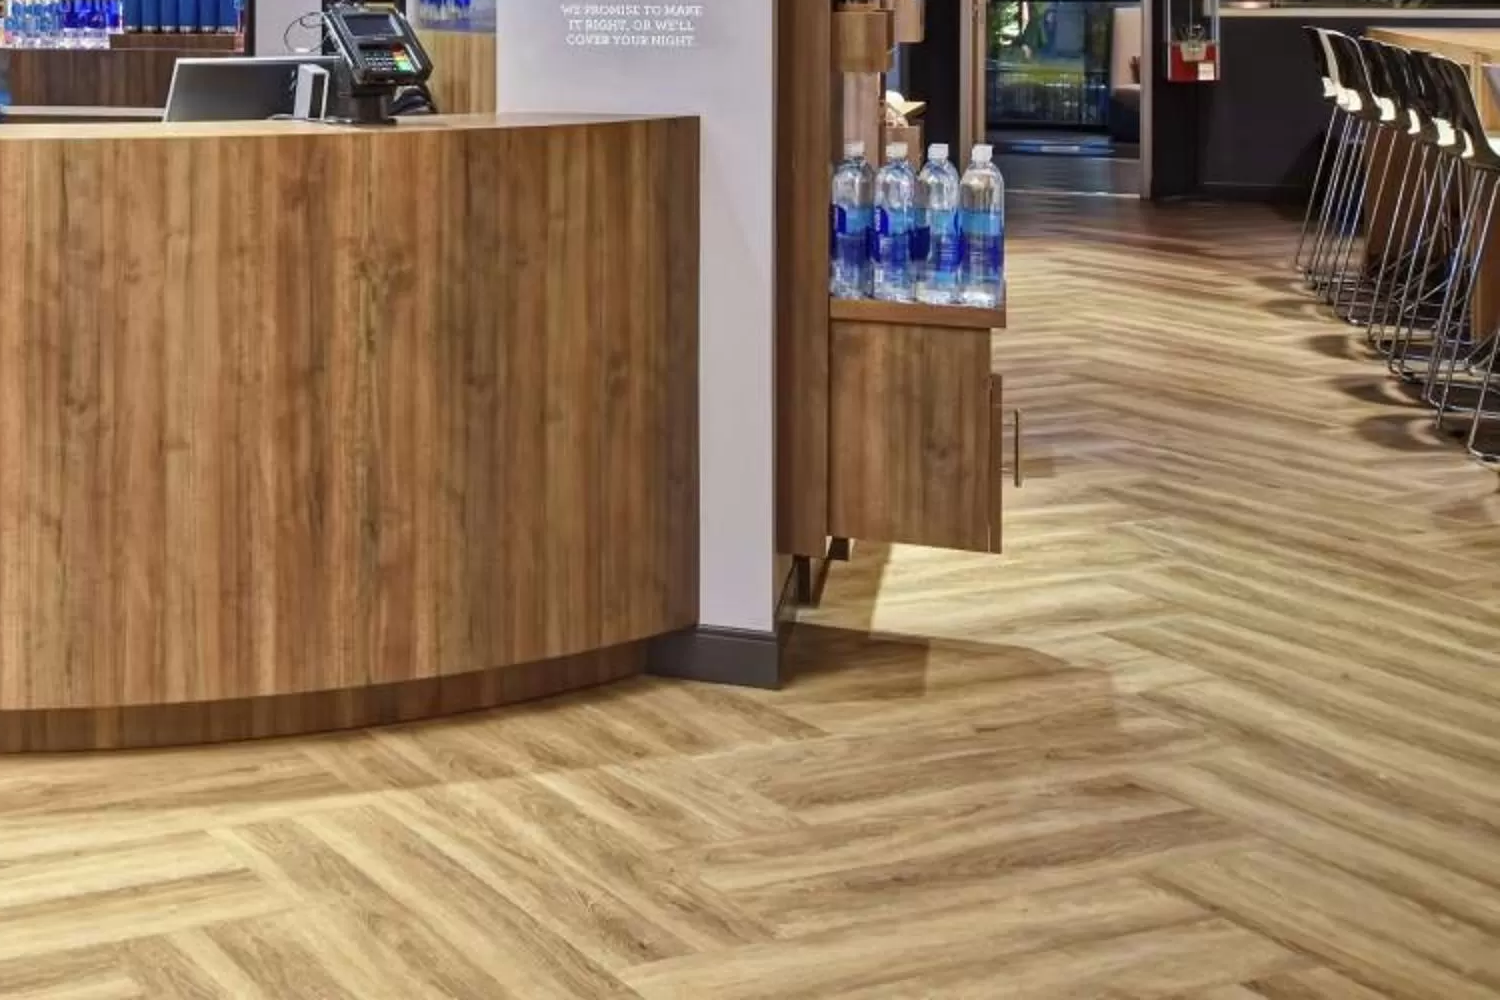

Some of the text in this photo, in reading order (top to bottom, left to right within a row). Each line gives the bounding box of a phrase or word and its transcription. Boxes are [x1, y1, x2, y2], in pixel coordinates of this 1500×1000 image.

[583, 4, 641, 16] PROMISE
[643, 5, 661, 16] TO
[664, 4, 704, 16] MAKE
[568, 19, 584, 31] IT
[655, 19, 695, 31] WE'LL
[566, 33, 610, 45] COVER
[612, 34, 648, 46] YOUR
